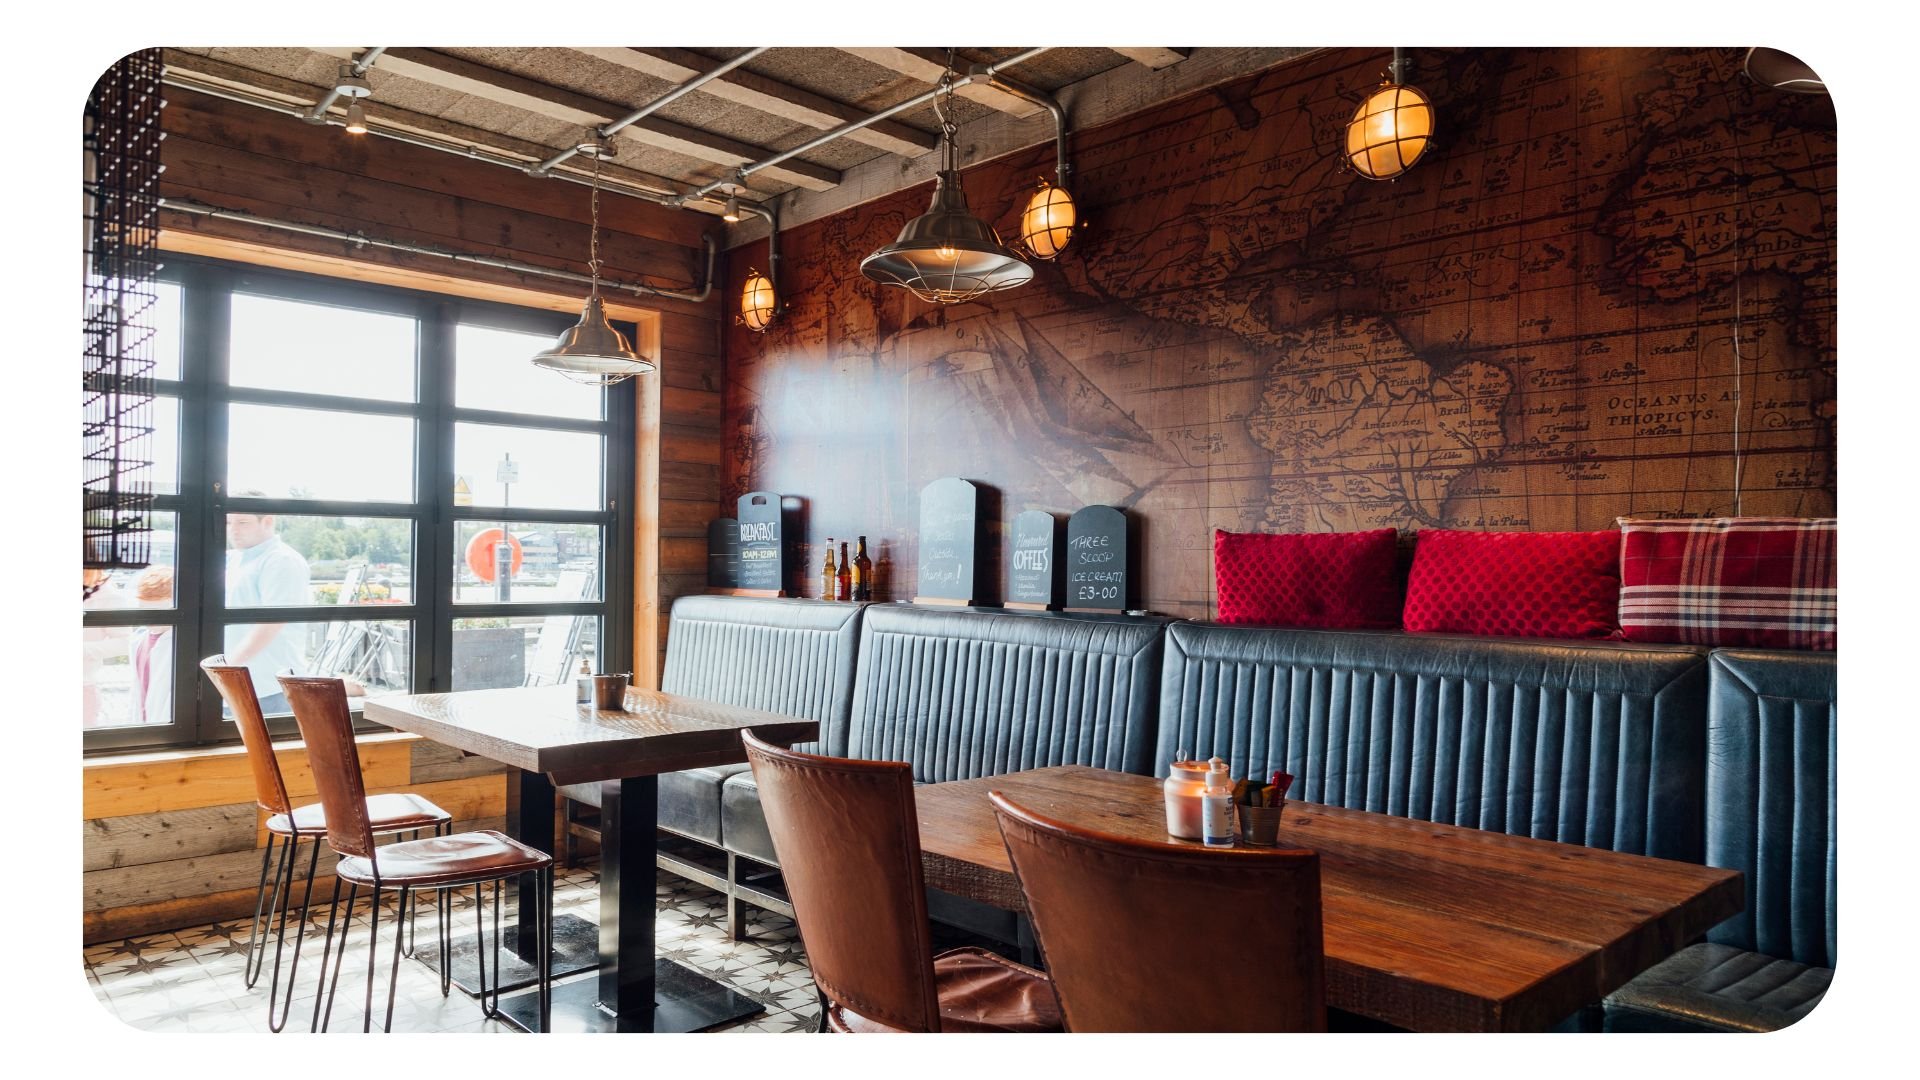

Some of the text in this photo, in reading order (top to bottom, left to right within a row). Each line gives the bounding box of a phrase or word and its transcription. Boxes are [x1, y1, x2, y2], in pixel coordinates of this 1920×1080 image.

[1608, 392, 1708, 411] OCEANVS
[1070, 535, 1110, 550] THREE
[1013, 547, 1049, 573] COFFEES
[1078, 551, 1114, 565] SCOOP
[1078, 586, 1118, 600] £3-00
